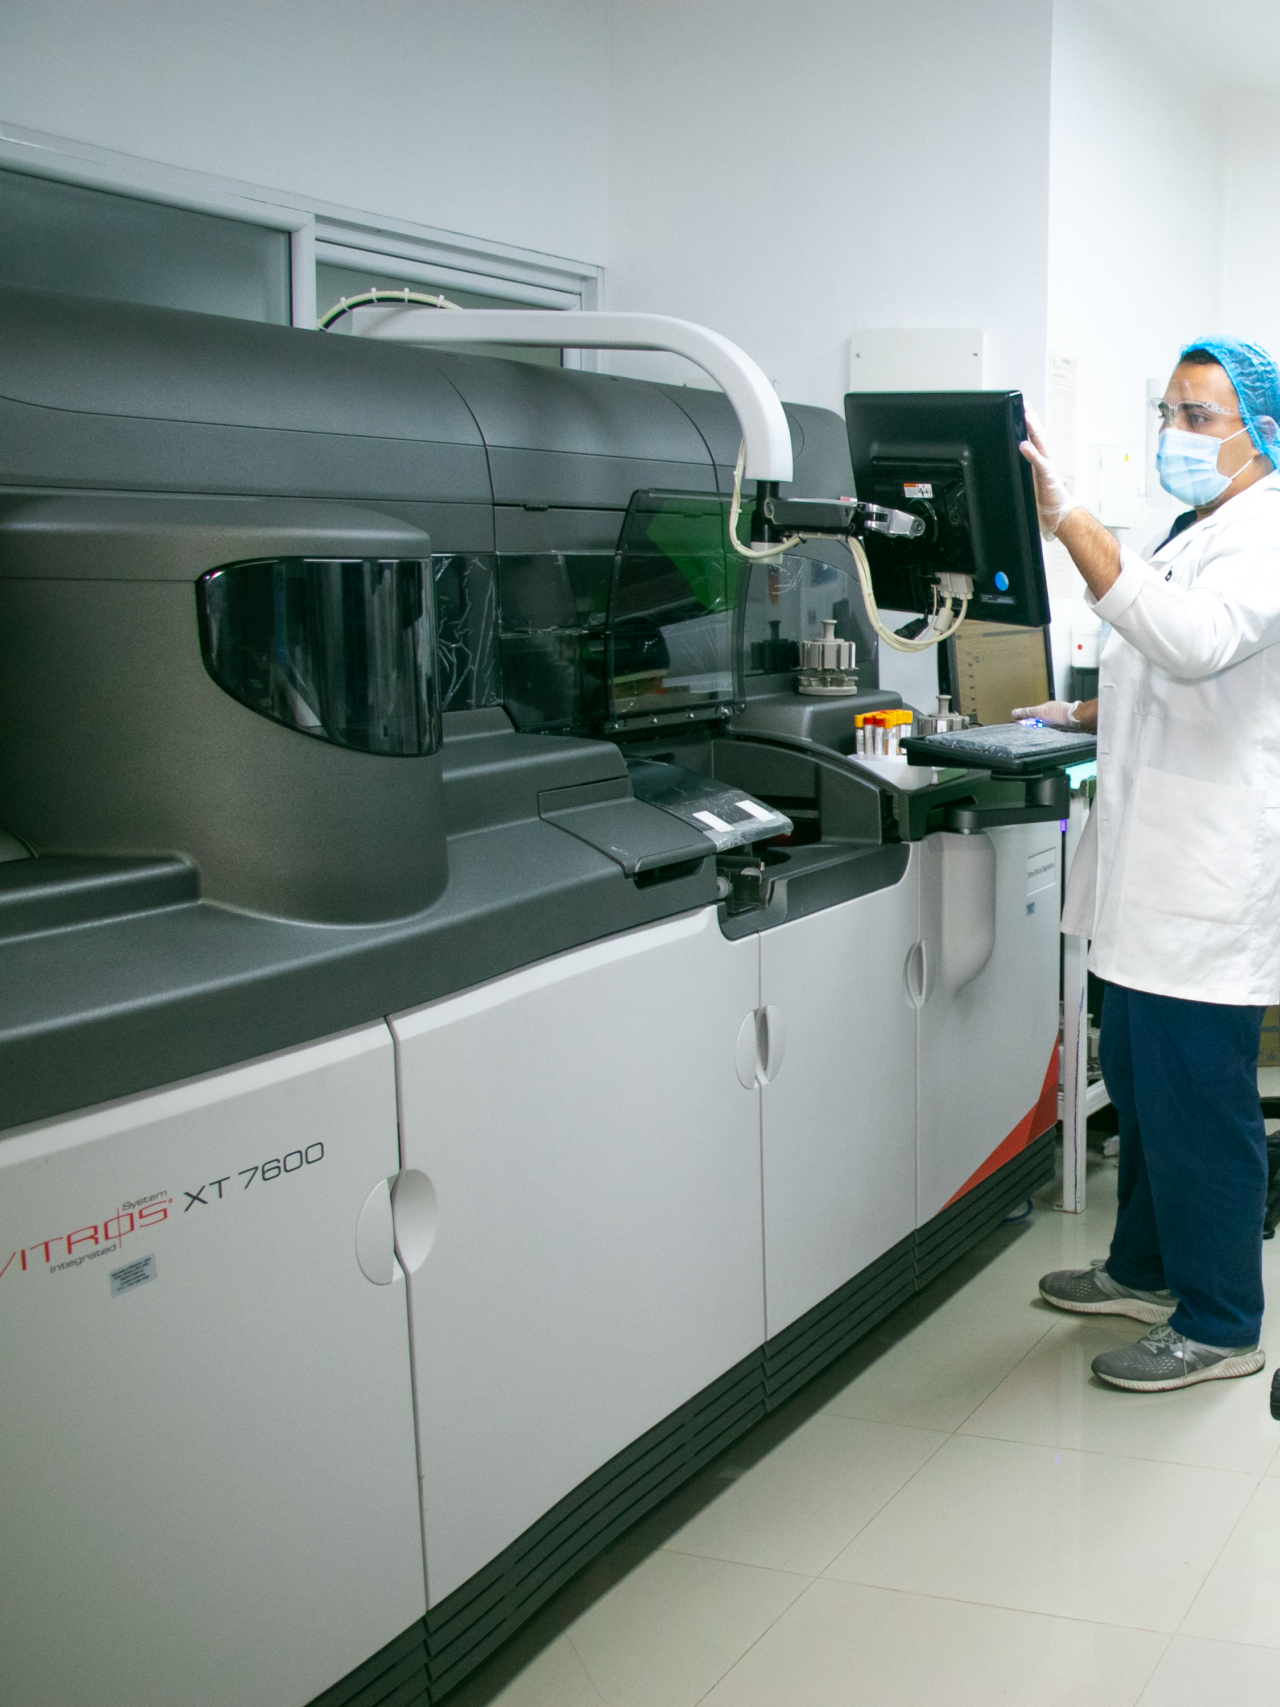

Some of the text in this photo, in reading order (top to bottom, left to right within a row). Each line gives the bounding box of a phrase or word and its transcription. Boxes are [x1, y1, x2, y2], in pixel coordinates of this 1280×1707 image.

[183, 1176, 231, 1212] XT
[238, 1142, 325, 1190] 7600
[122, 1190, 167, 1212] System
[50, 1243, 117, 1274] Integrated
